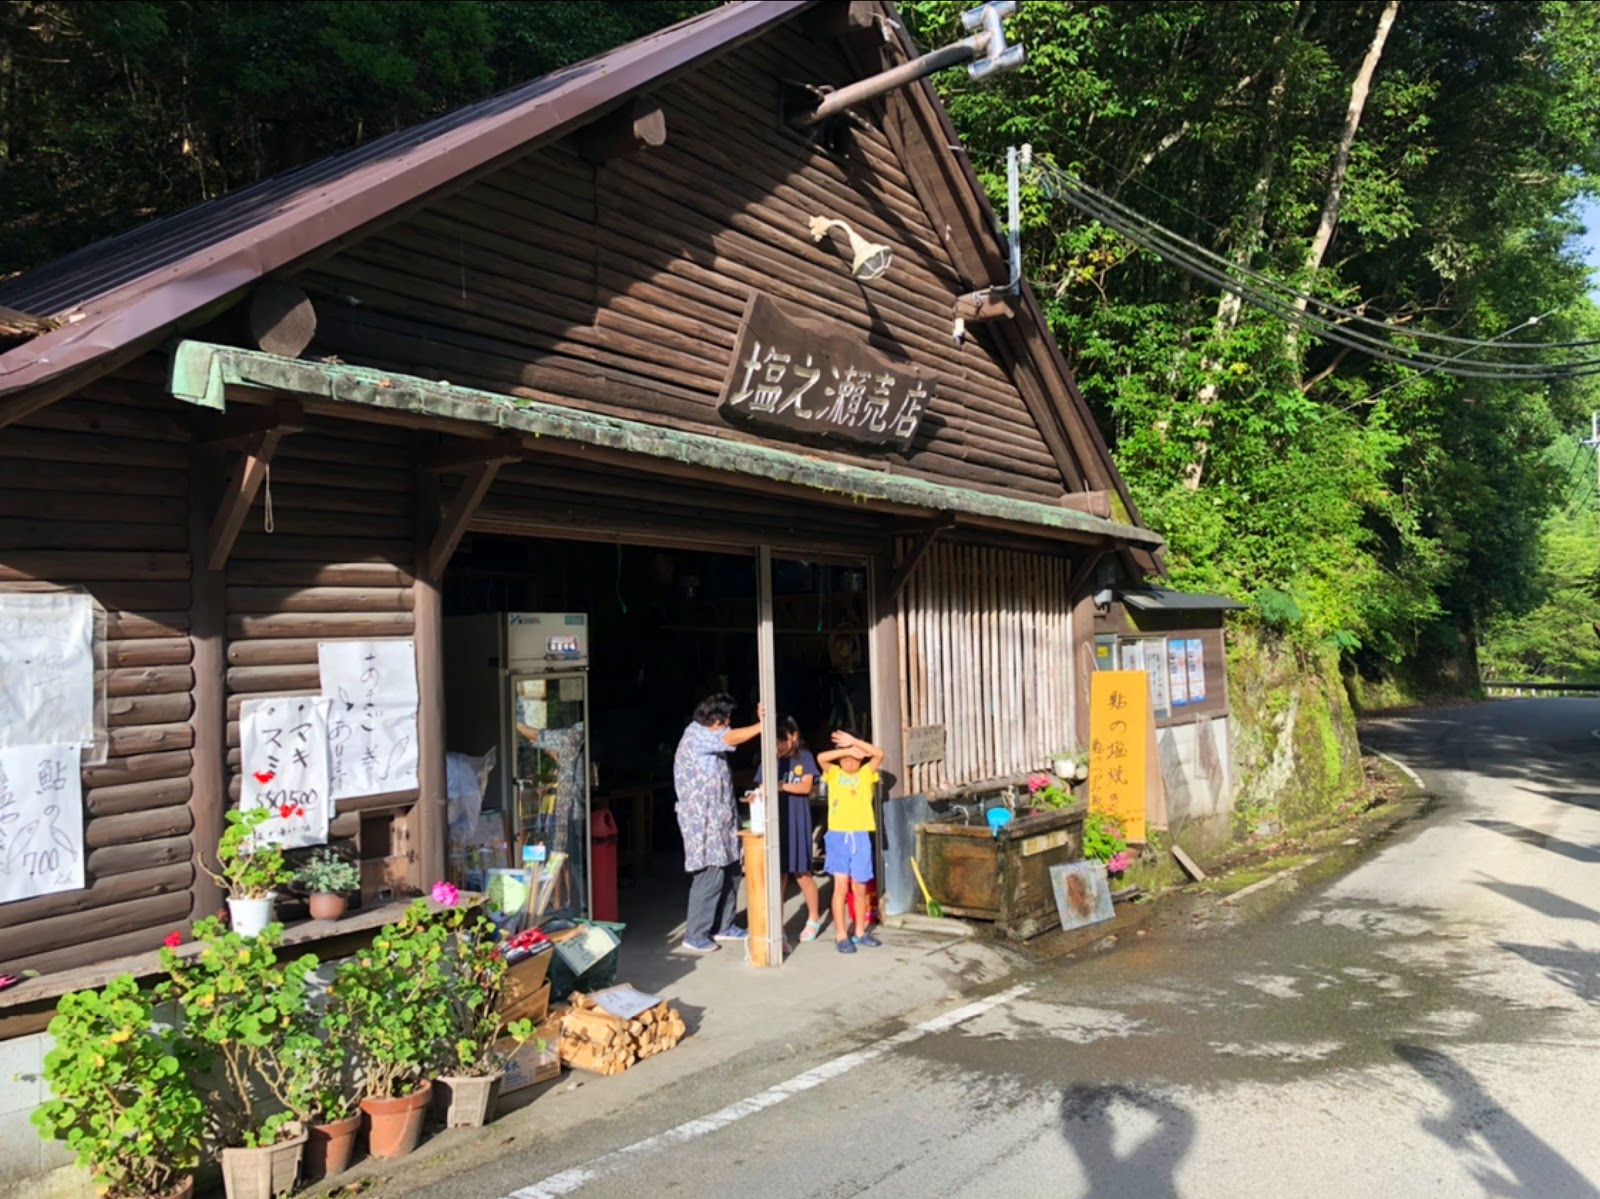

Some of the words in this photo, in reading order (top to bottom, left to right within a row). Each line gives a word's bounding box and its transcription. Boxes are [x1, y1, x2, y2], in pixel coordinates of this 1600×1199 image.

[261, 728, 283, 776] スミ
[288, 722, 313, 769] マキ
[289, 788, 318, 807] 500
[23, 848, 59, 879] 700
